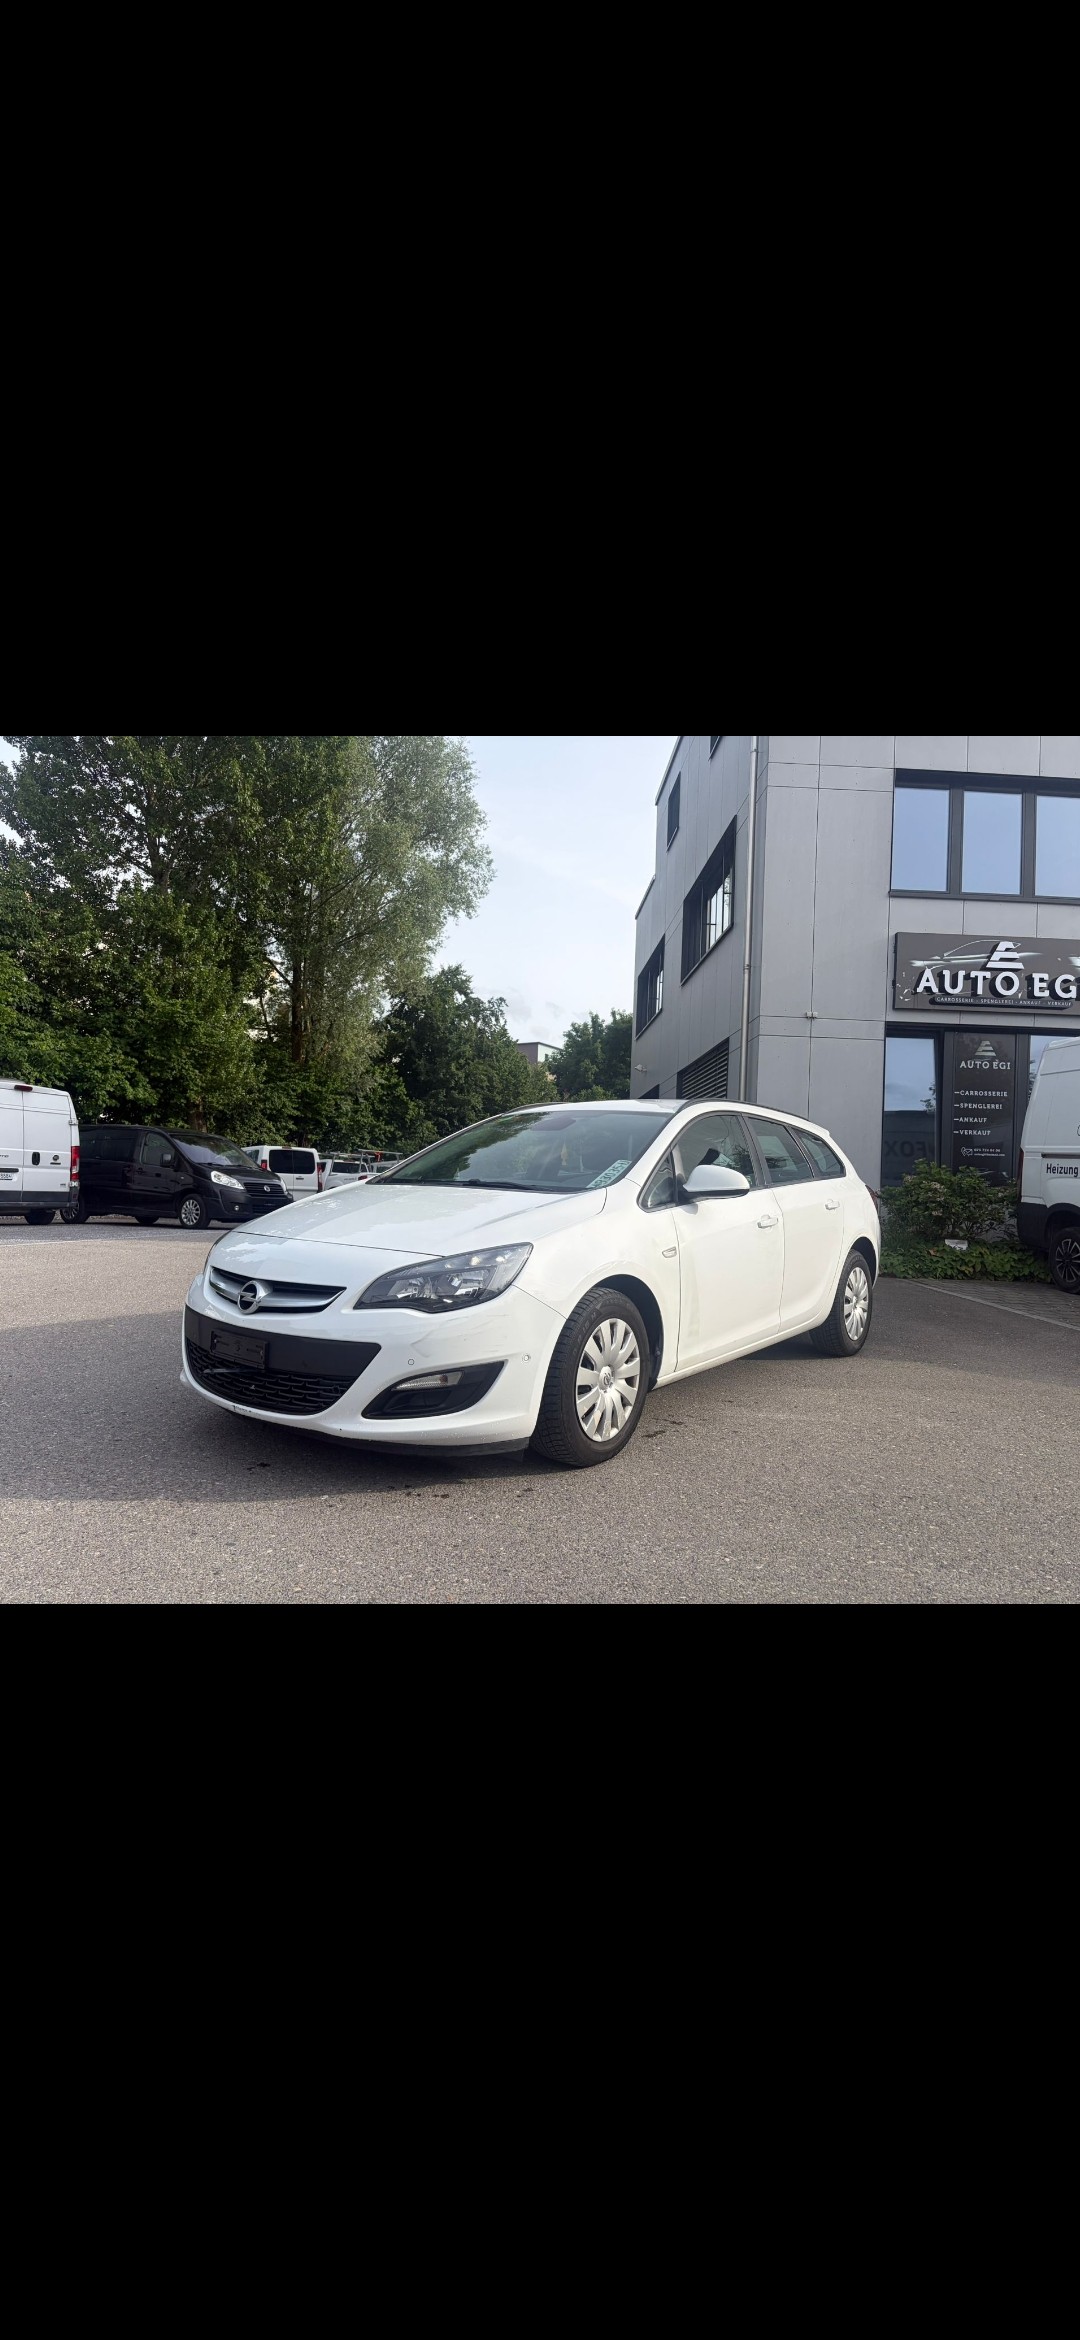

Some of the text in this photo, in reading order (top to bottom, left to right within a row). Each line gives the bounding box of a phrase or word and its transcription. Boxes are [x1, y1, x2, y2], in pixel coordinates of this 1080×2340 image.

[916, 968, 1077, 999] AUTO EG
[960, 1060, 1011, 1070] AUTO EGI
[1046, 1162, 1079, 1178] Heizung
